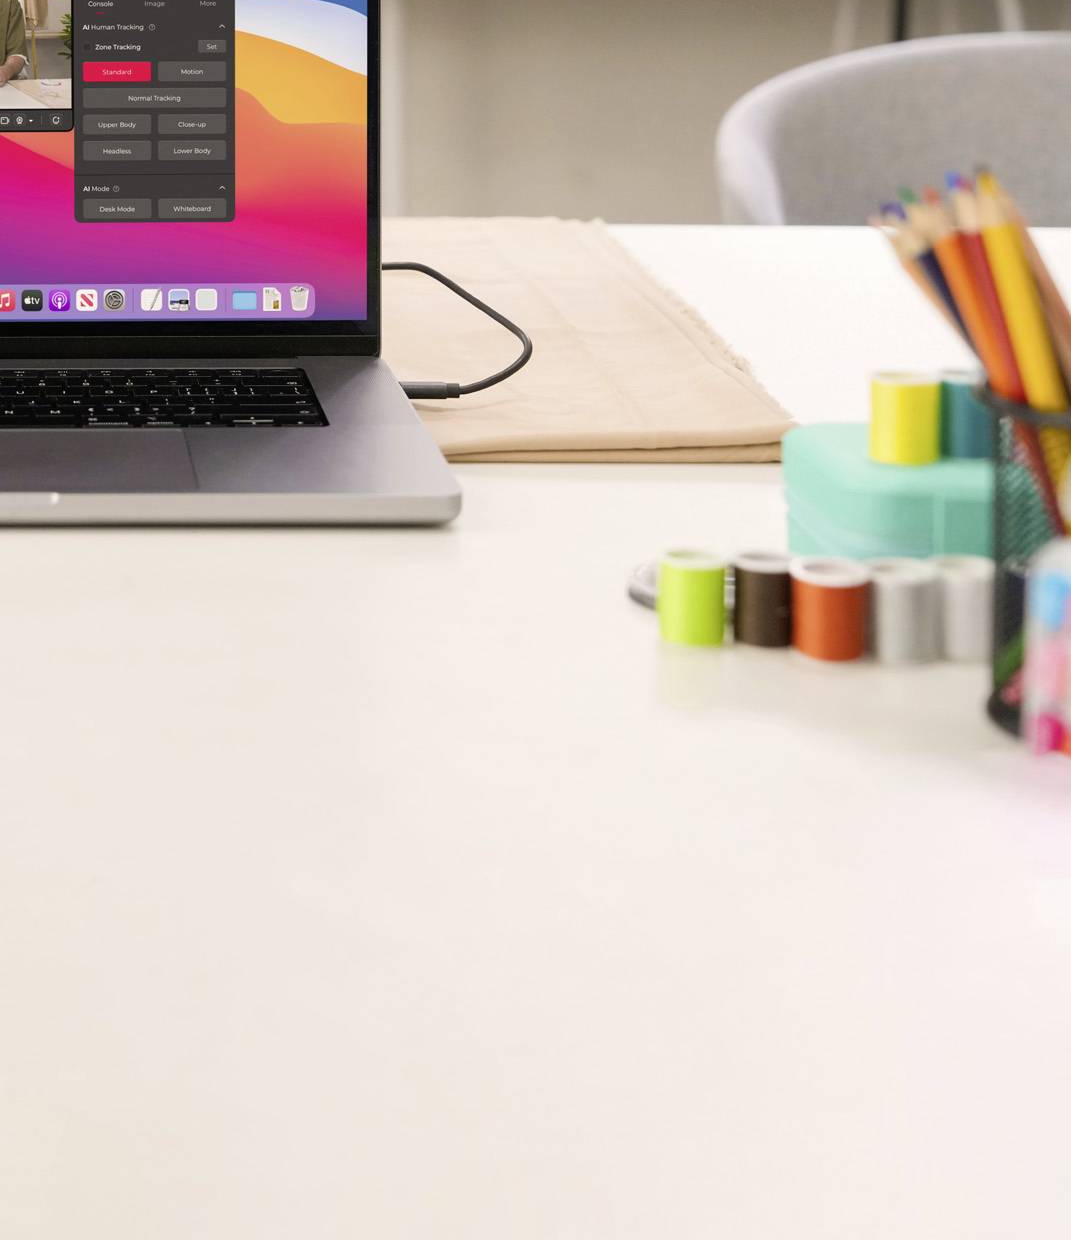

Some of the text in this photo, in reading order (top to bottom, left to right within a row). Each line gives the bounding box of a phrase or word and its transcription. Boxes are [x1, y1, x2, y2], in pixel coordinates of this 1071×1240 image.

[88, 0, 114, 8] Console
[144, 0, 165, 9] Image
[199, 0, 217, 8] More
[82, 23, 144, 33] AI Human Tracking
[95, 43, 141, 53] Zone Tracking
[102, 68, 132, 76] Standard
[180, 68, 204, 76] Motion
[128, 94, 182, 104] Normal Tracking
[98, 121, 137, 130] Upper Body
[177, 120, 207, 130] Close-up
[102, 147, 132, 155] Headless
[173, 147, 212, 156] Lower Body
[99, 205, 136, 213] Desk Mode
[31, 296, 41, 304] tv
